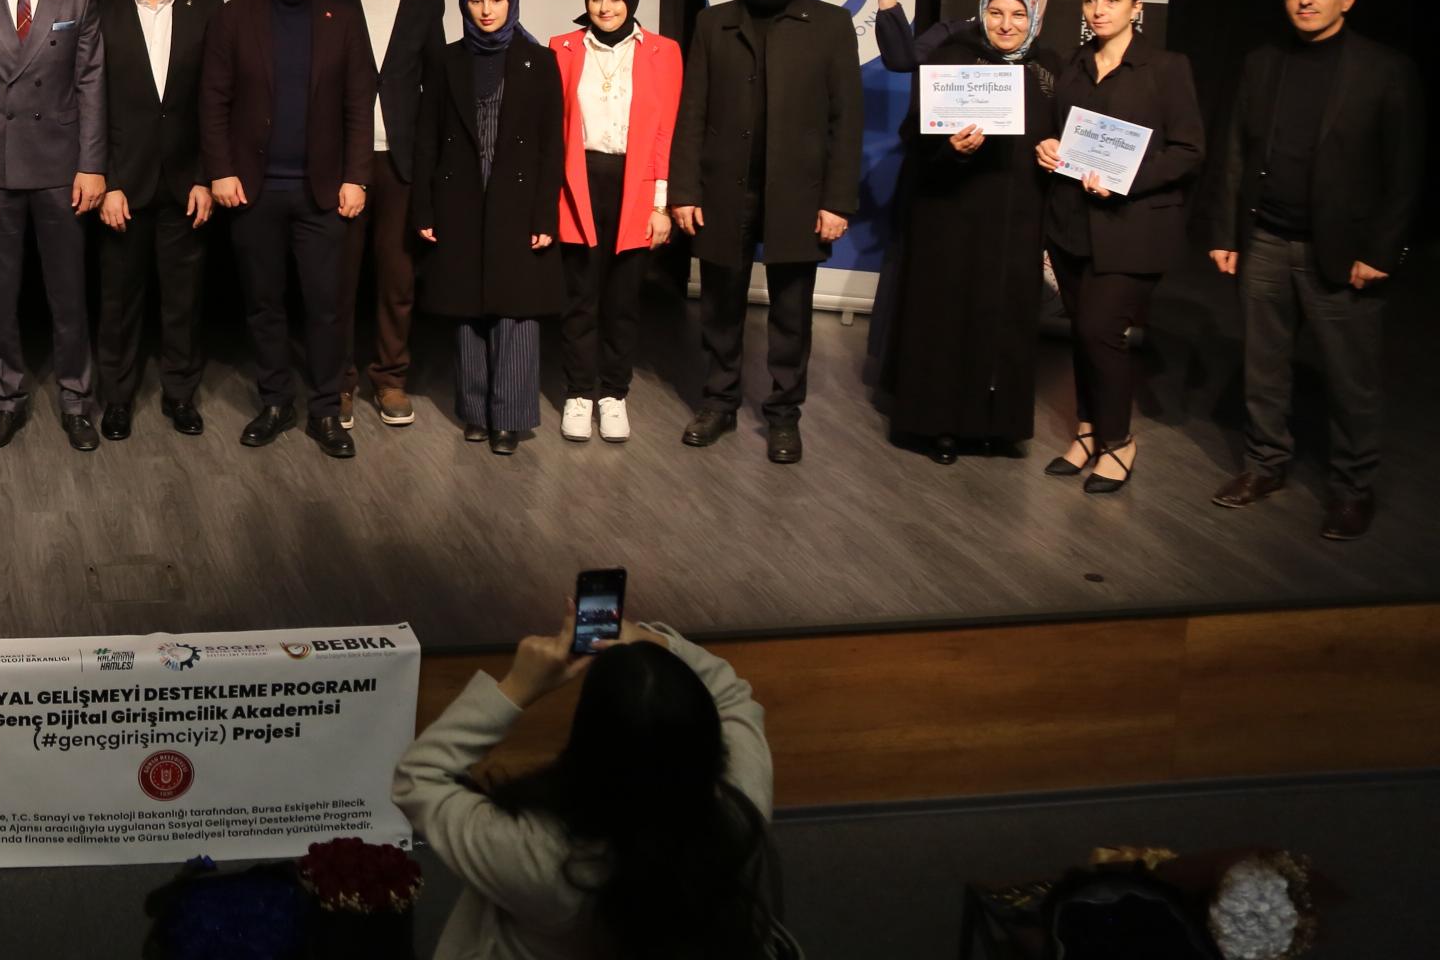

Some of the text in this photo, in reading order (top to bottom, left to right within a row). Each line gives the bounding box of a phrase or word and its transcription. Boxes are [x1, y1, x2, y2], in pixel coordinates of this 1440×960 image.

[312, 637, 396, 651] BEBKA
[37, 685, 140, 707] GELİŞMEYİ
[144, 684, 267, 701] DESTEKLEME
[271, 678, 377, 697] PROGRAMI
[46, 710, 106, 730] Dijital
[111, 705, 228, 727] Girişimcilik
[232, 700, 341, 720] Akademisi
[33, 722, 300, 752] (#gençgirişimciyiz) Projesi
[10, 824, 42, 833] Ajansı
[45, 823, 104, 834] aracılığıyla
[108, 822, 165, 833] uygulanan
[169, 820, 202, 832] Sosyal
[205, 817, 257, 828] Gelişmeyi
[260, 814, 321, 824] Destekleme
[324, 810, 371, 821] Programı
[34, 814, 70, 823] Sanayi
[89, 812, 135, 822] Teknoloji
[138, 808, 187, 820] Bakanlığı
[190, 807, 249, 817] tarafından,
[252, 806, 282, 814] Bursa
[285, 802, 329, 813] Eskişehir
[332, 799, 365, 808] Bilecik
[25, 834, 64, 843] finanse
[67, 834, 120, 843] edilmekte
[172, 829, 225, 841] Belediyesi
[228, 827, 283, 837] tarafından
[286, 821, 373, 836] yürütülmektedir.
